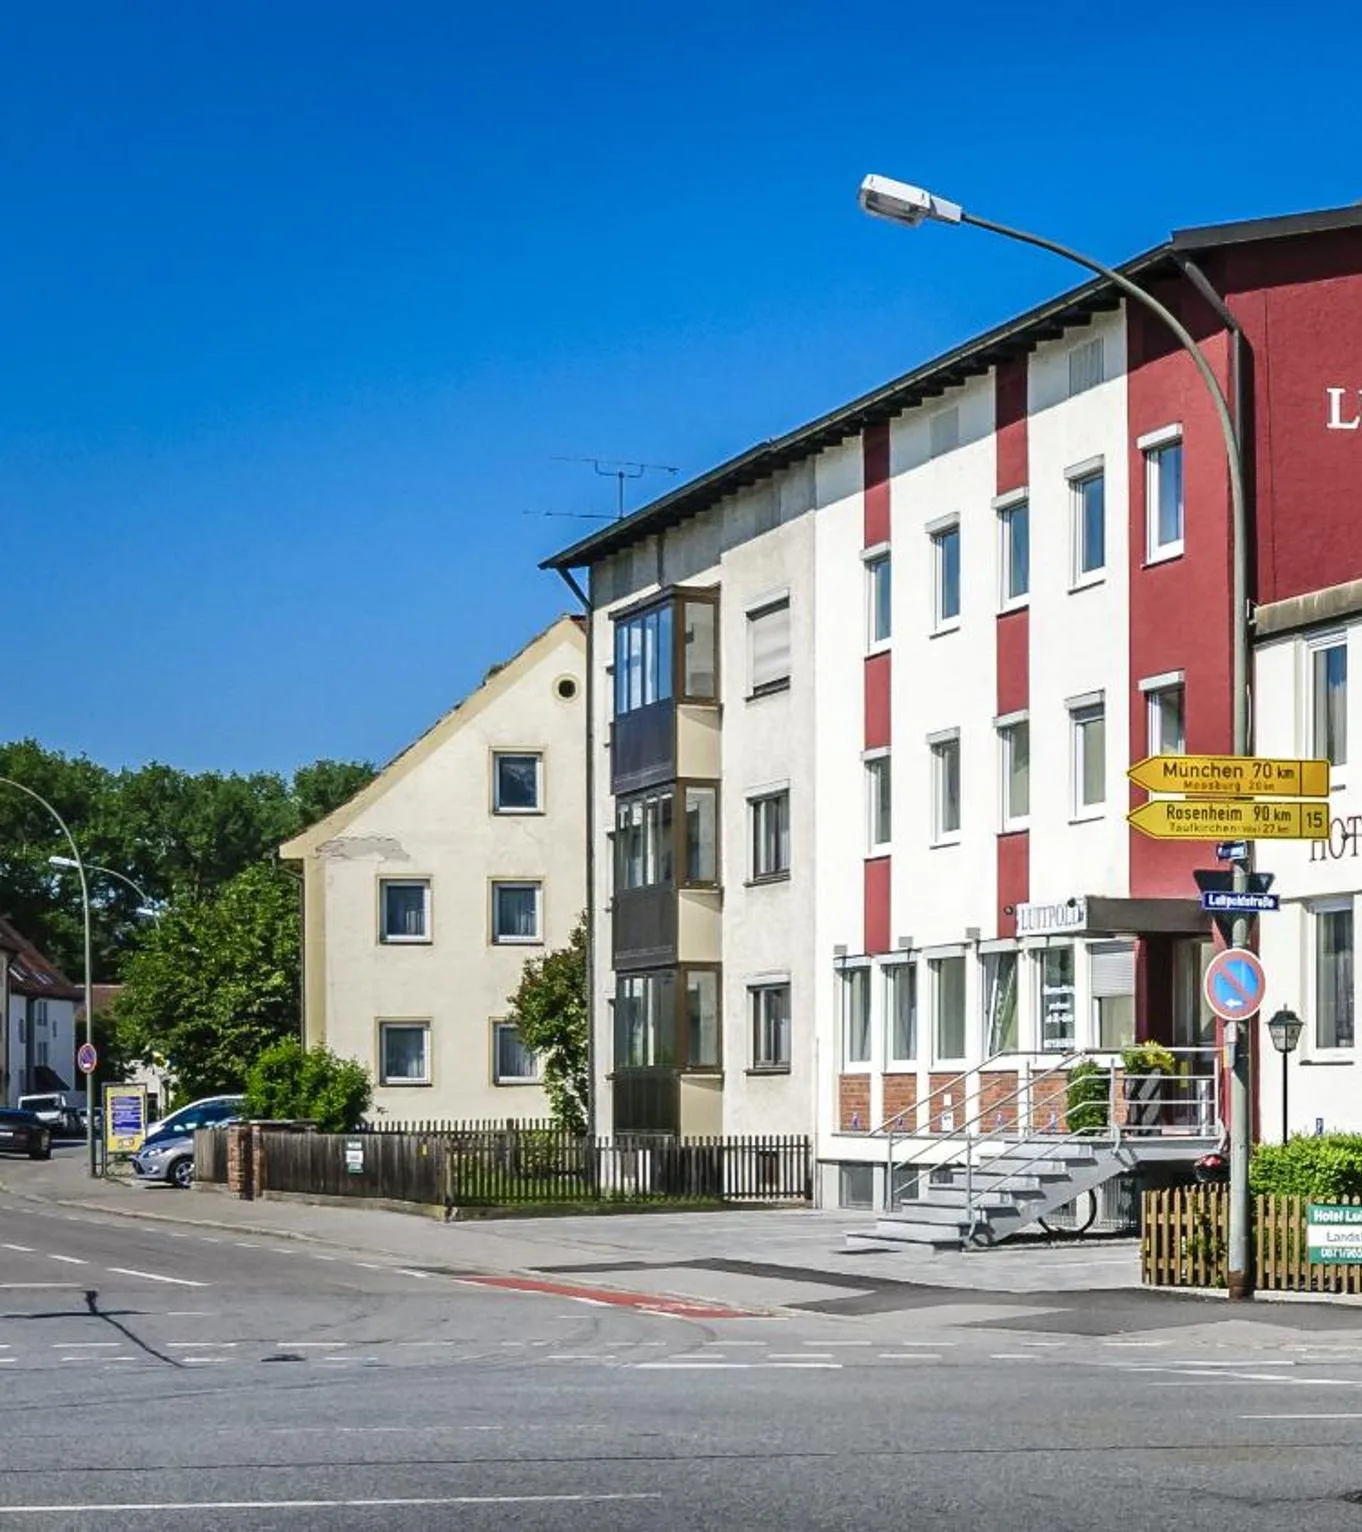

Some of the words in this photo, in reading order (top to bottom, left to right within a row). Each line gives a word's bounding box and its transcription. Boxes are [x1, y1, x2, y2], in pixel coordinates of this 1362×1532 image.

[1163, 761, 1243, 778] München
[1252, 762, 1272, 779] 70
[1277, 766, 1295, 779] km
[1183, 780, 1241, 792] Moosburg
[1166, 804, 1243, 821] Rosenheim
[1253, 805, 1270, 821] 90
[1274, 807, 1292, 822] km
[1306, 811, 1323, 829] 15
[1263, 823, 1275, 833] 27
[1021, 903, 1084, 930] LUITPOLD
[1313, 1210, 1343, 1222] Hotel
